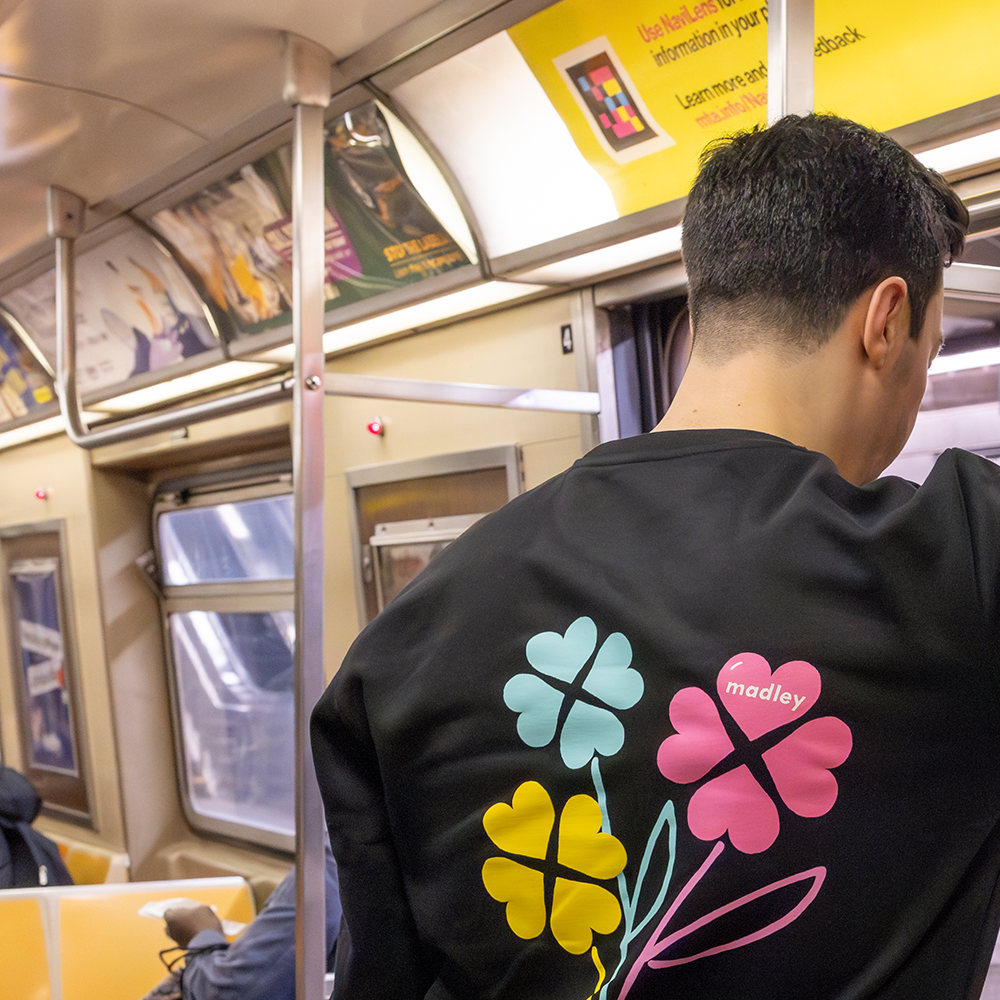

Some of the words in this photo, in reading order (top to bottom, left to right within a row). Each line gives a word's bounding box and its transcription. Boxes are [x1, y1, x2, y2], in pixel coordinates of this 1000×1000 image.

[637, 23, 665, 43] Use
[659, 0, 718, 35] NaviLens
[650, 29, 721, 67] information
[715, 21, 734, 39] in
[730, 11, 760, 38] your
[675, 85, 715, 110] Learn
[711, 74, 747, 97] more
[744, 60, 768, 84] and
[695, 90, 768, 128] mta.info/Na
[725, 681, 807, 712] madley
